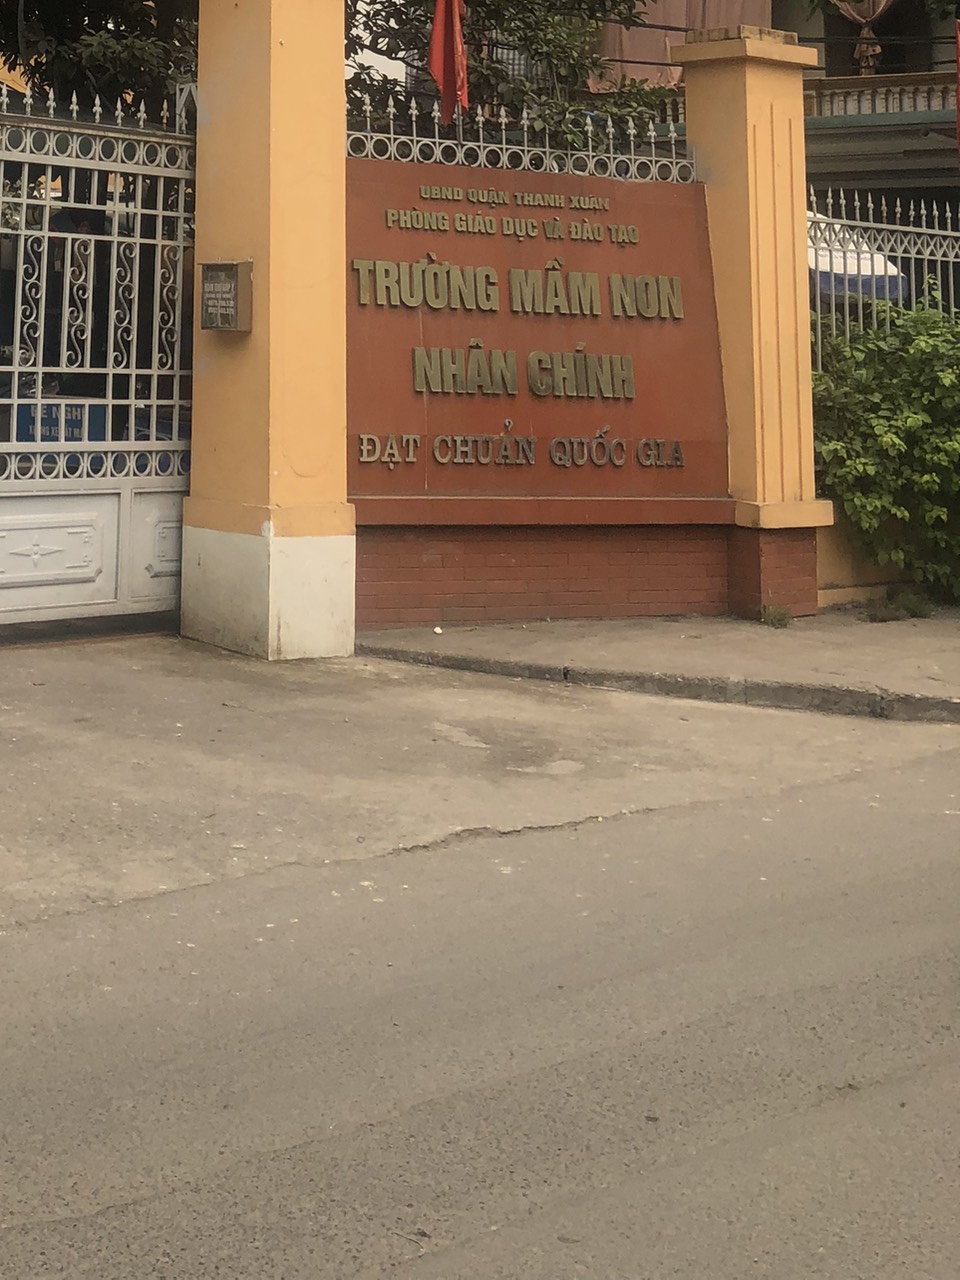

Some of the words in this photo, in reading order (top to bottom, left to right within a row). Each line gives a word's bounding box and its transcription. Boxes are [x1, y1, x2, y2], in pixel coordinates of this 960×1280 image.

[419, 184, 464, 202] UBND
[467, 186, 510, 209] QUẬN
[514, 191, 565, 209] THANH
[386, 206, 450, 232] PHÒNG
[454, 209, 497, 235] GIÁO
[501, 216, 539, 243] DỤC
[543, 215, 565, 240] VÀ
[569, 217, 605, 242] ĐÀO
[608, 223, 640, 248] TẠO
[353, 251, 500, 312] TRƯỜNG
[509, 256, 602, 316] MẦM
[608, 273, 685, 320] NON
[412, 337, 519, 395] NHÂN
[527, 341, 637, 400] CHÍNH
[357, 433, 420, 471] ĐẠT
[549, 424, 628, 468] QUỐC
[637, 437, 686, 468] GIA
